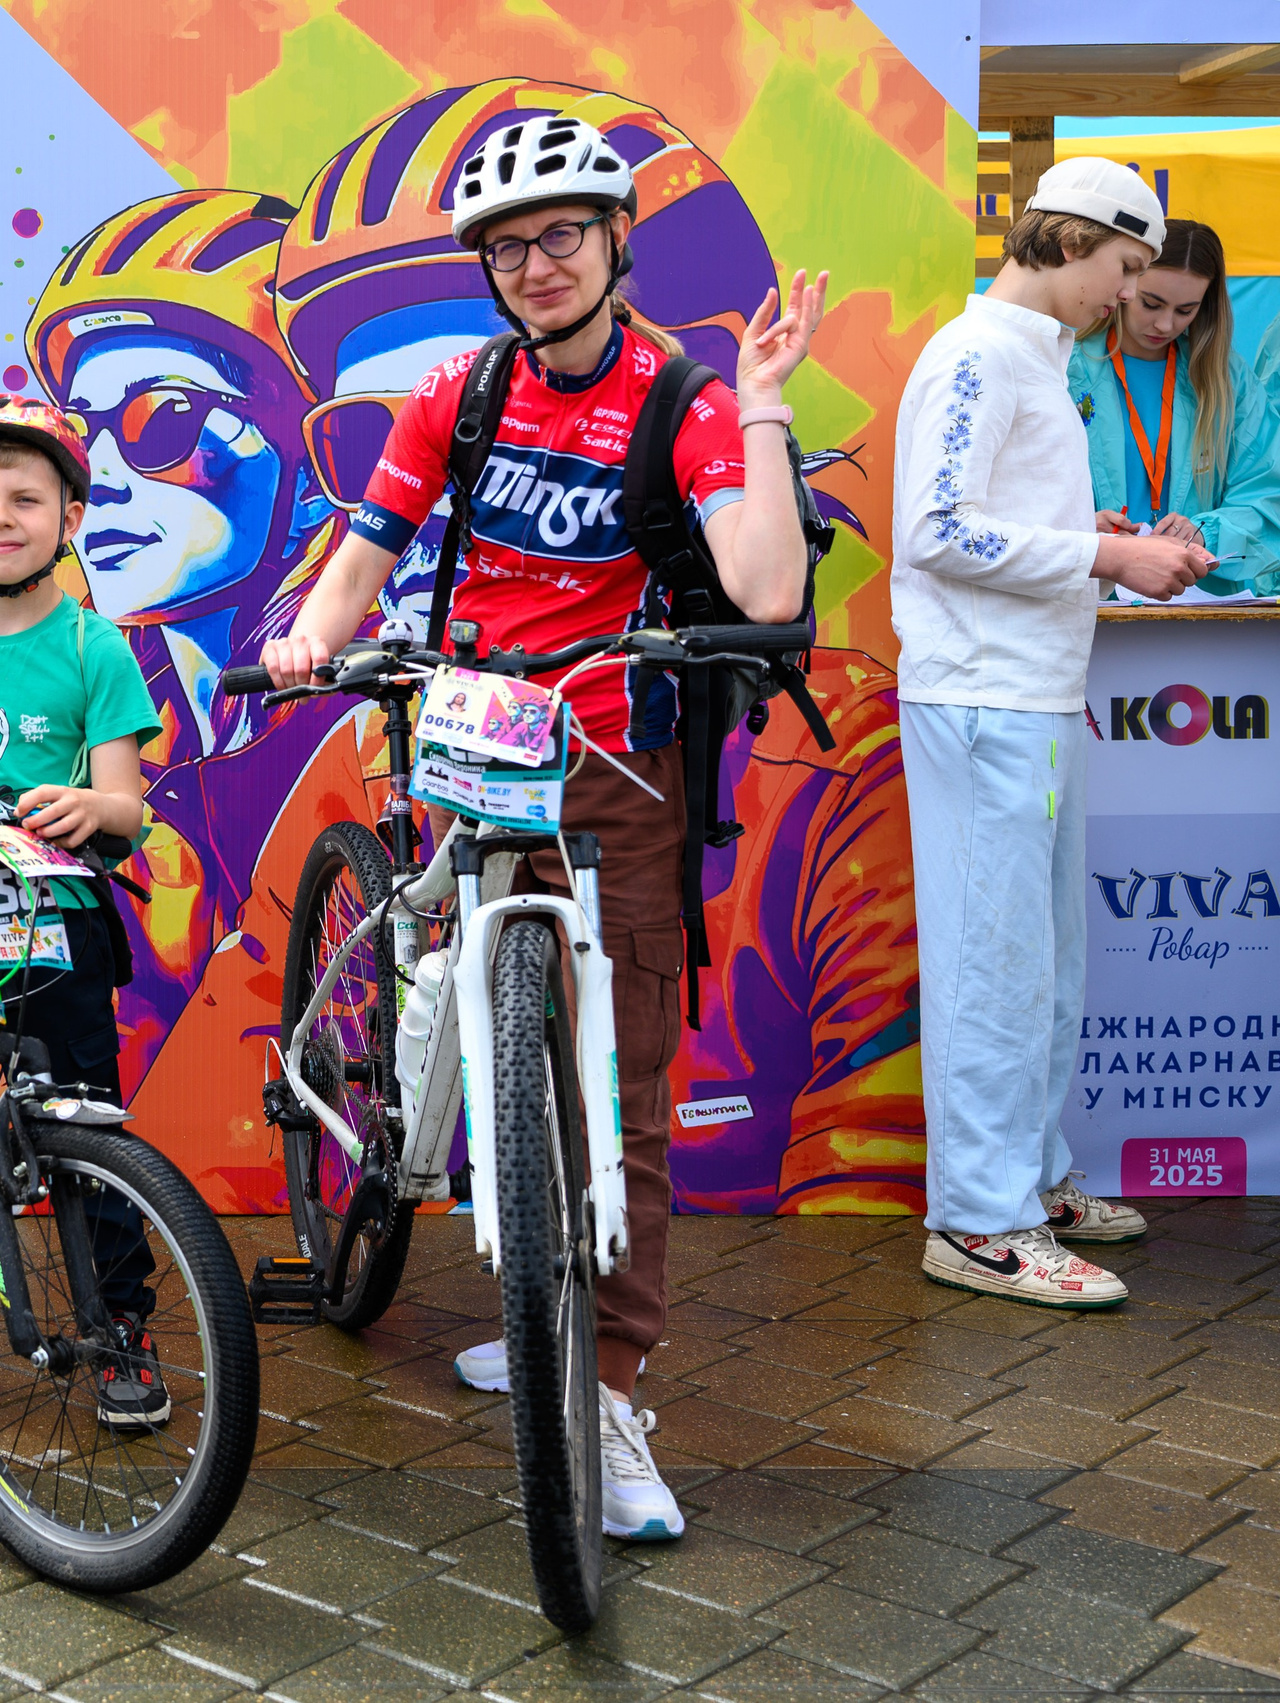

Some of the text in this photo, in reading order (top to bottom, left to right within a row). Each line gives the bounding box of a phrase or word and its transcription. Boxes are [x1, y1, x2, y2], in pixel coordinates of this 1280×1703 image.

[477, 352, 497, 392] POLAR
[424, 714, 475, 735] 00678
[1111, 684, 1269, 746] KOLA
[1091, 867, 1280, 920] VIVA
[1148, 926, 1230, 969] Ровар
[1080, 1015, 1280, 1040] ІЖНАРОД
[1080, 1051, 1280, 1074] ЛАКАРНАВ
[1085, 1085, 1272, 1110] У МІНСКУ
[1149, 1148, 1216, 1164] 31 МАЯ
[1149, 1165, 1223, 1187] 2025
[298, 1233, 312, 1258] DALE
